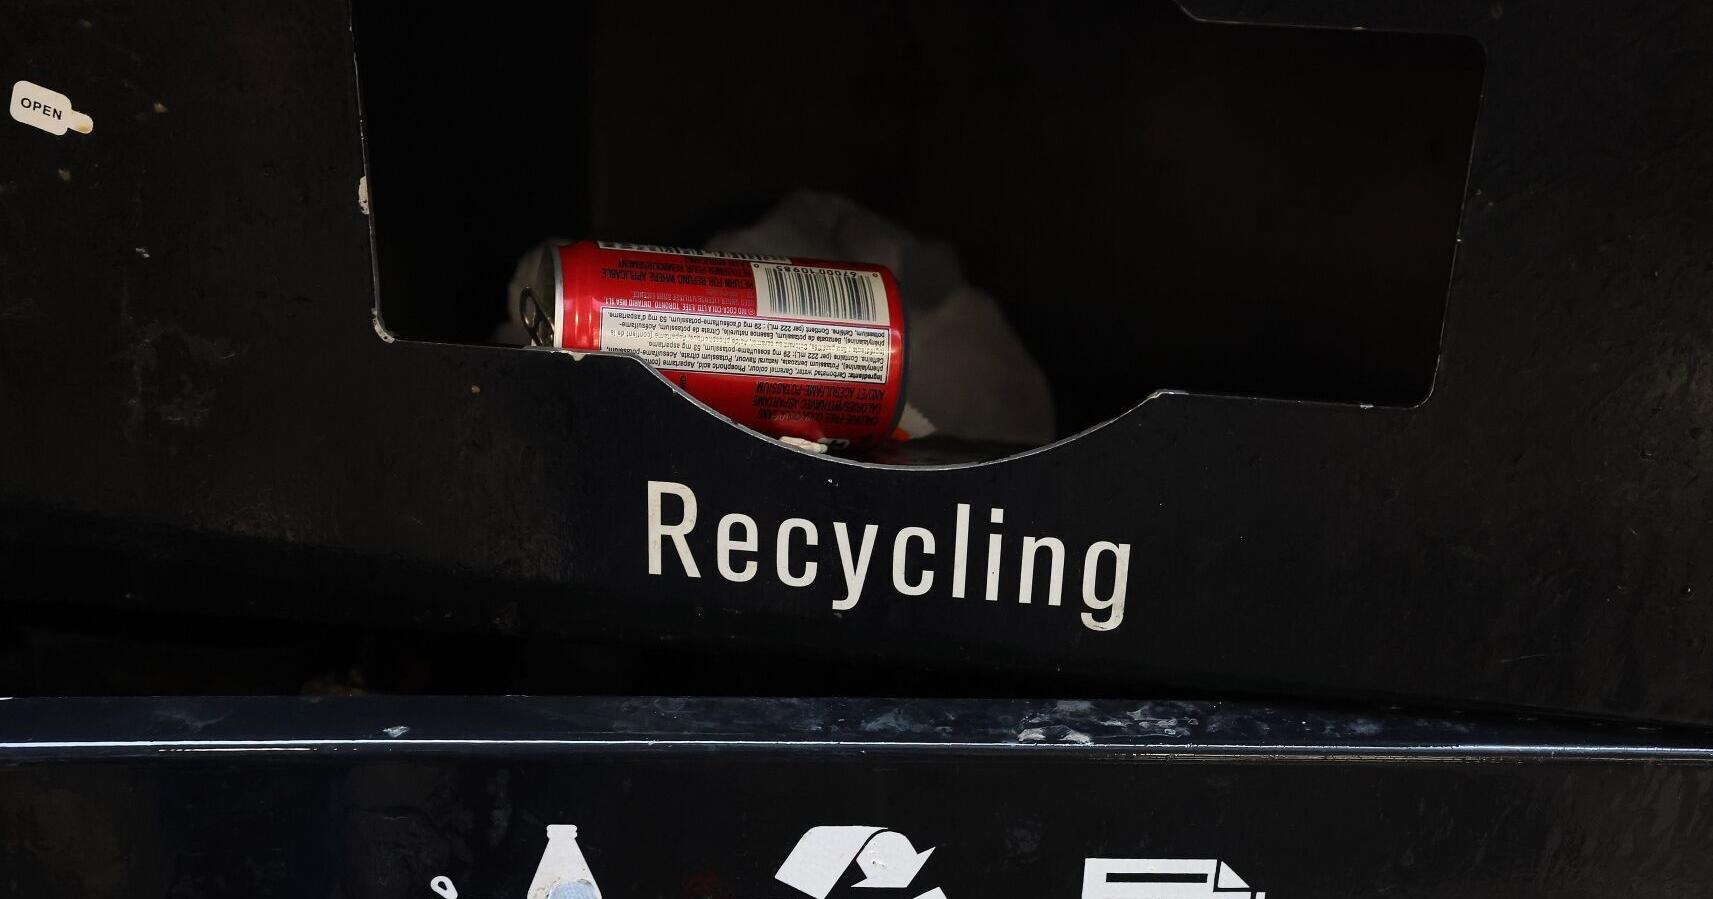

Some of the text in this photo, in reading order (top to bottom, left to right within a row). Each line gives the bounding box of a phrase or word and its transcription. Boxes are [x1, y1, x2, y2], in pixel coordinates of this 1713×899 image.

[21, 97, 62, 120] OPEN
[774, 265, 814, 274] 10985
[819, 269, 856, 277] 67000
[601, 267, 753, 289] RETURN FOR REFUND WHERE APPLICABLE
[657, 322, 691, 332] potassium,
[766, 322, 778, 330] mL)
[805, 326, 829, 334] Contient
[721, 327, 748, 336] naturelle,
[749, 330, 773, 338] Essence
[775, 331, 806, 341] potassium,
[854, 328, 884, 338] potassium,
[816, 335, 841, 343] Benzoate
[646, 339, 680, 349] aspartame.
[678, 351, 700, 359] citrate,
[701, 353, 732, 362] Potassium
[733, 354, 756, 363] flavour,
[833, 353, 858, 361] Contains
[661, 357, 695, 367] Aspartame
[696, 360, 711, 369] acid,
[757, 357, 778, 365] Natural
[780, 358, 807, 367] benzoate,
[809, 361, 839, 369] Potassium
[711, 361, 746, 371] Phosphoric
[747, 364, 768, 373] colour,
[794, 367, 812, 376] water,
[813, 370, 846, 378] Carbonated
[847, 371, 882, 381] Ingredients:
[648, 481, 1130, 631] Recycling
